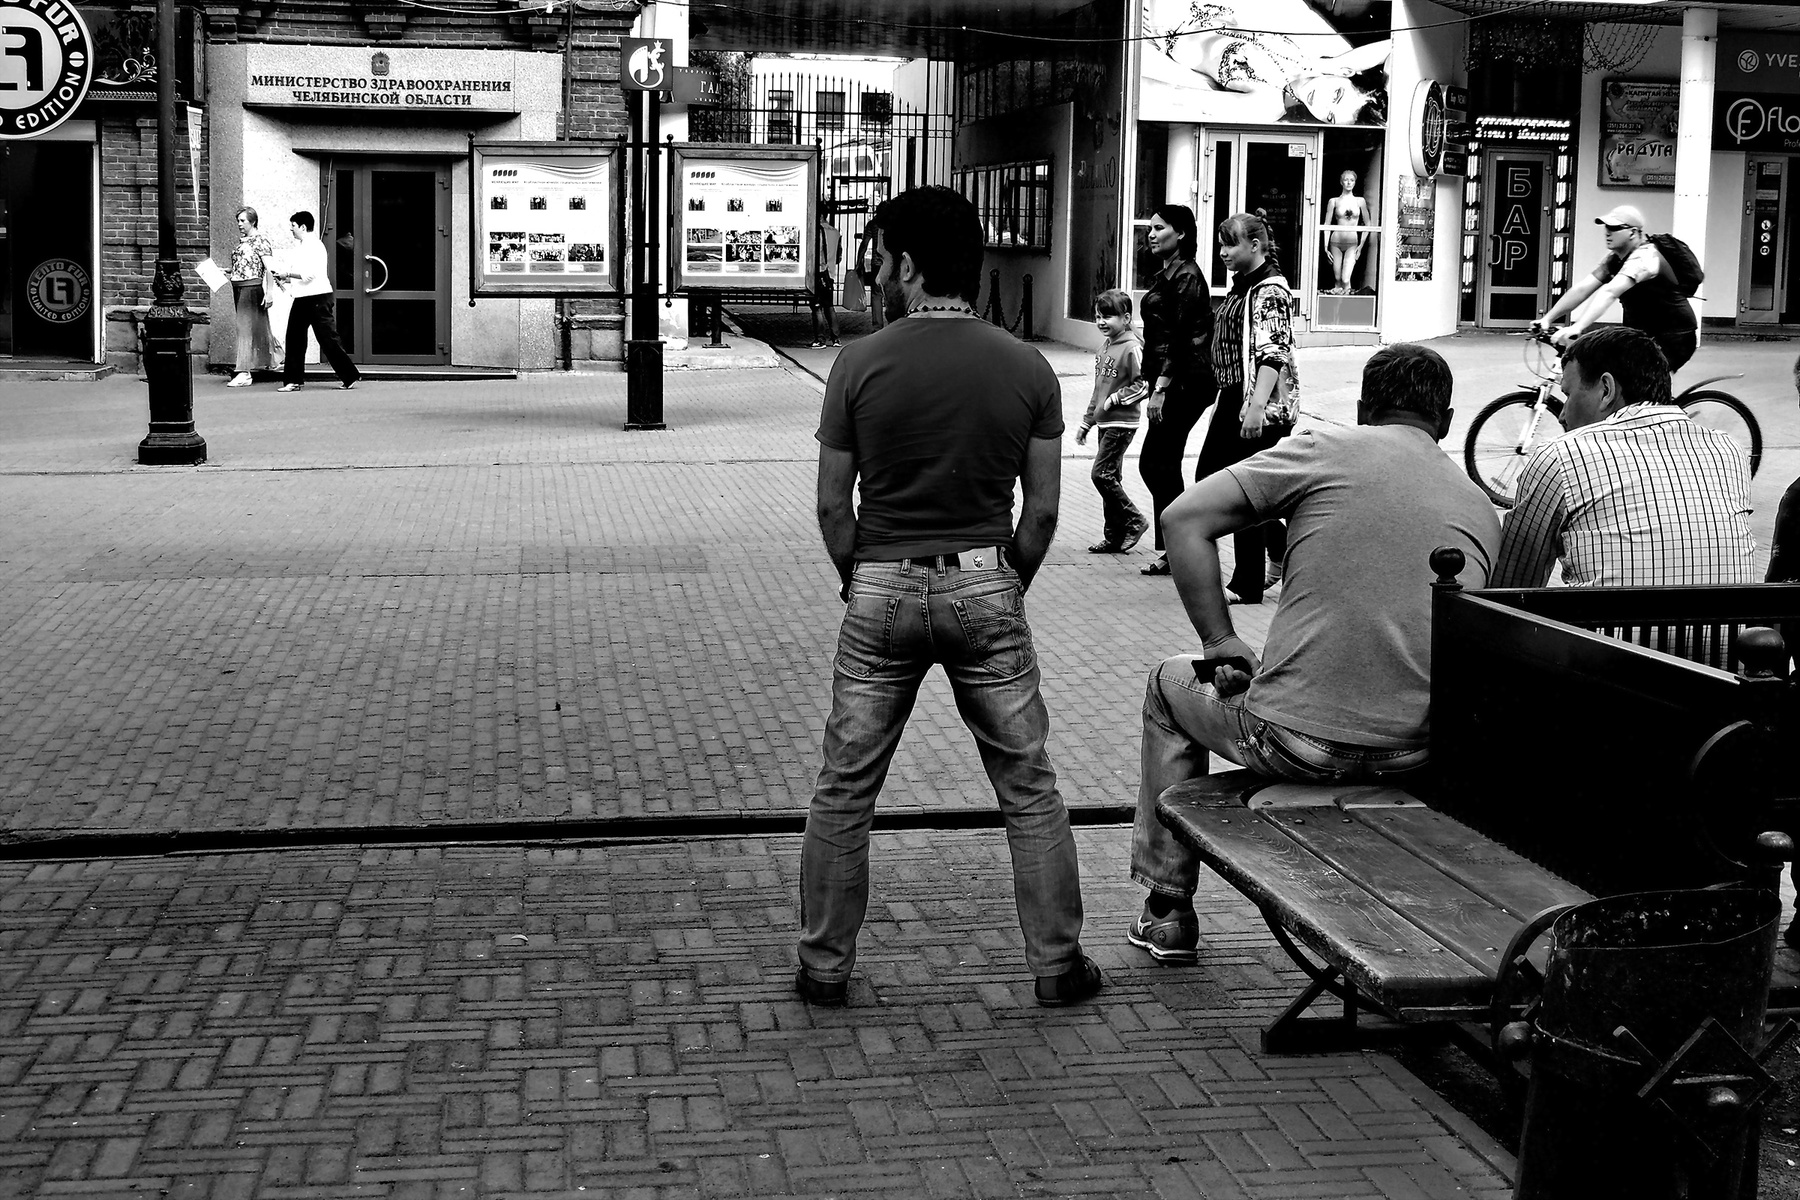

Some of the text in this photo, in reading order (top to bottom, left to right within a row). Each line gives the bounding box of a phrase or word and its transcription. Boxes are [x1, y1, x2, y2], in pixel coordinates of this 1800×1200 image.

[1765, 53, 1800, 68] YVE
[251, 75, 511, 92] МИНИСТЕРСТВО ЗДРАВООХРАНЕНИЯ
[15, 71, 82, 130] EDITION
[292, 90, 472, 106] ЧЕЛЯБИНСКОЙ ОБЛАСТИ
[1617, 142, 1673, 158] РАДУГА
[1502, 167, 1532, 270] БАР
[31, 262, 88, 287] LENTO FUR
[31, 295, 88, 320] LIMITED EDITION
